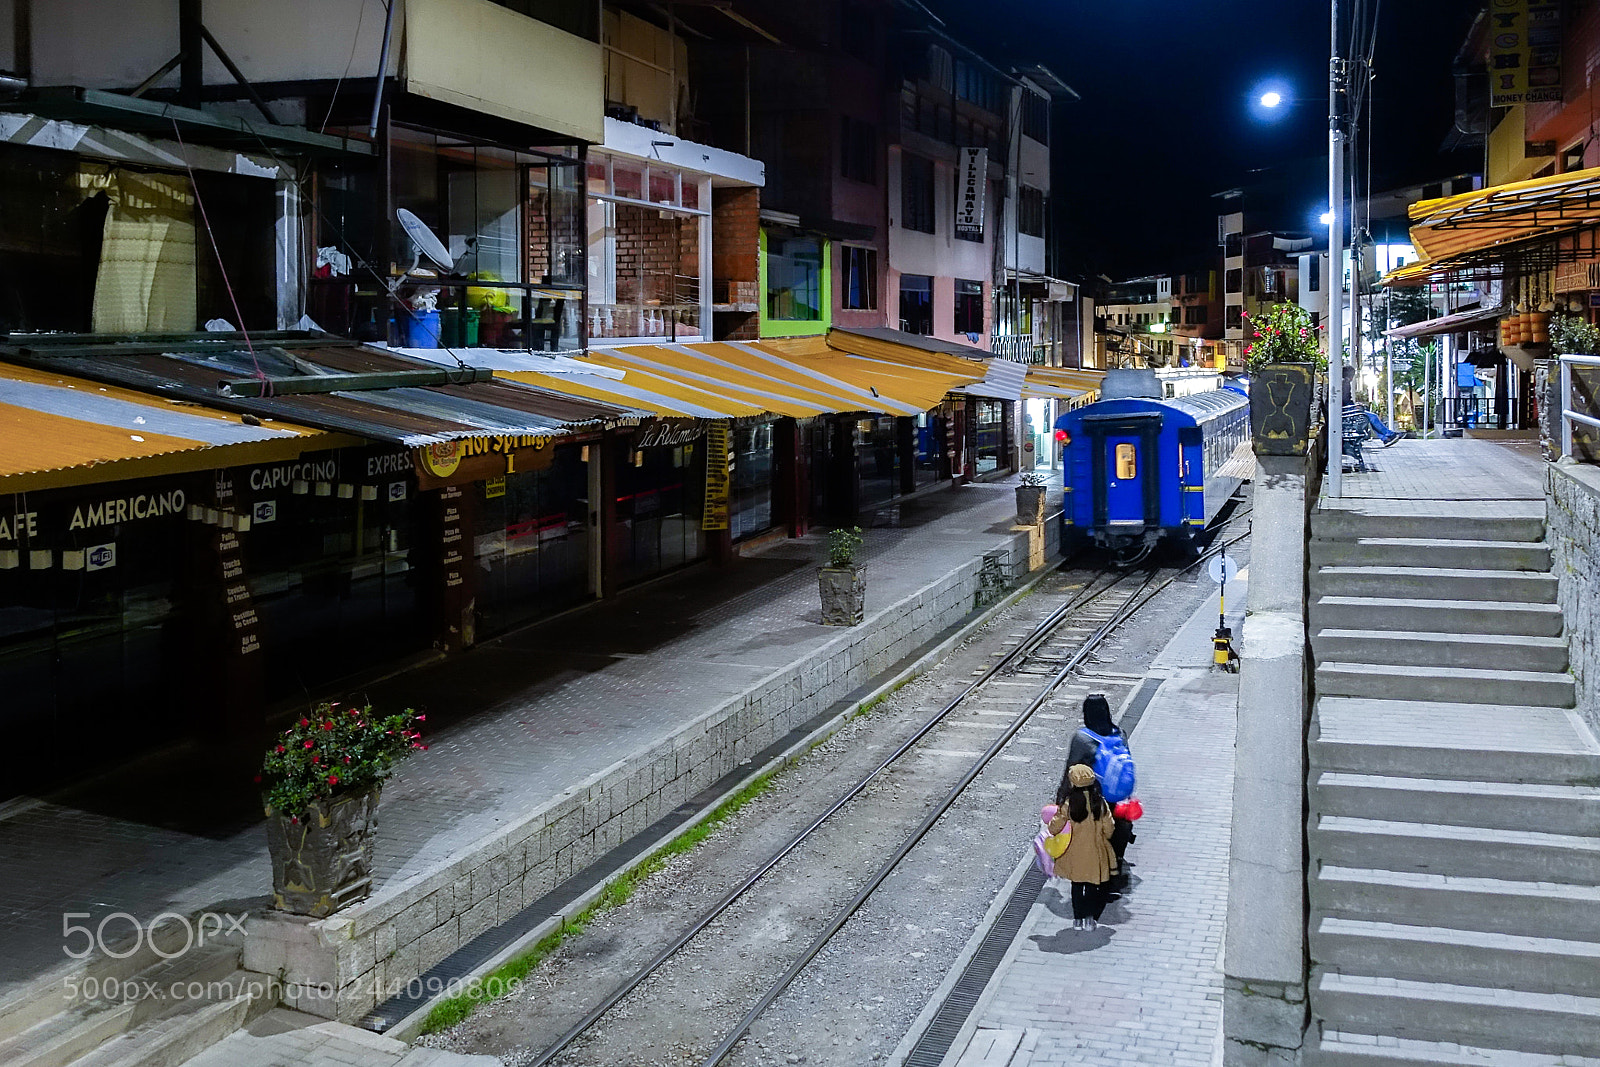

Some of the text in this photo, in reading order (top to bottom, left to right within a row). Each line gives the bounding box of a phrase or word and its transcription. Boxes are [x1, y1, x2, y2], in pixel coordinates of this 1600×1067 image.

[1493, 91, 1561, 103] MONEY CHANGE
[964, 148, 980, 223] WILLCAMAYU
[250, 459, 336, 490] CAPUCCINO
[69, 489, 185, 531] AMERICANO
